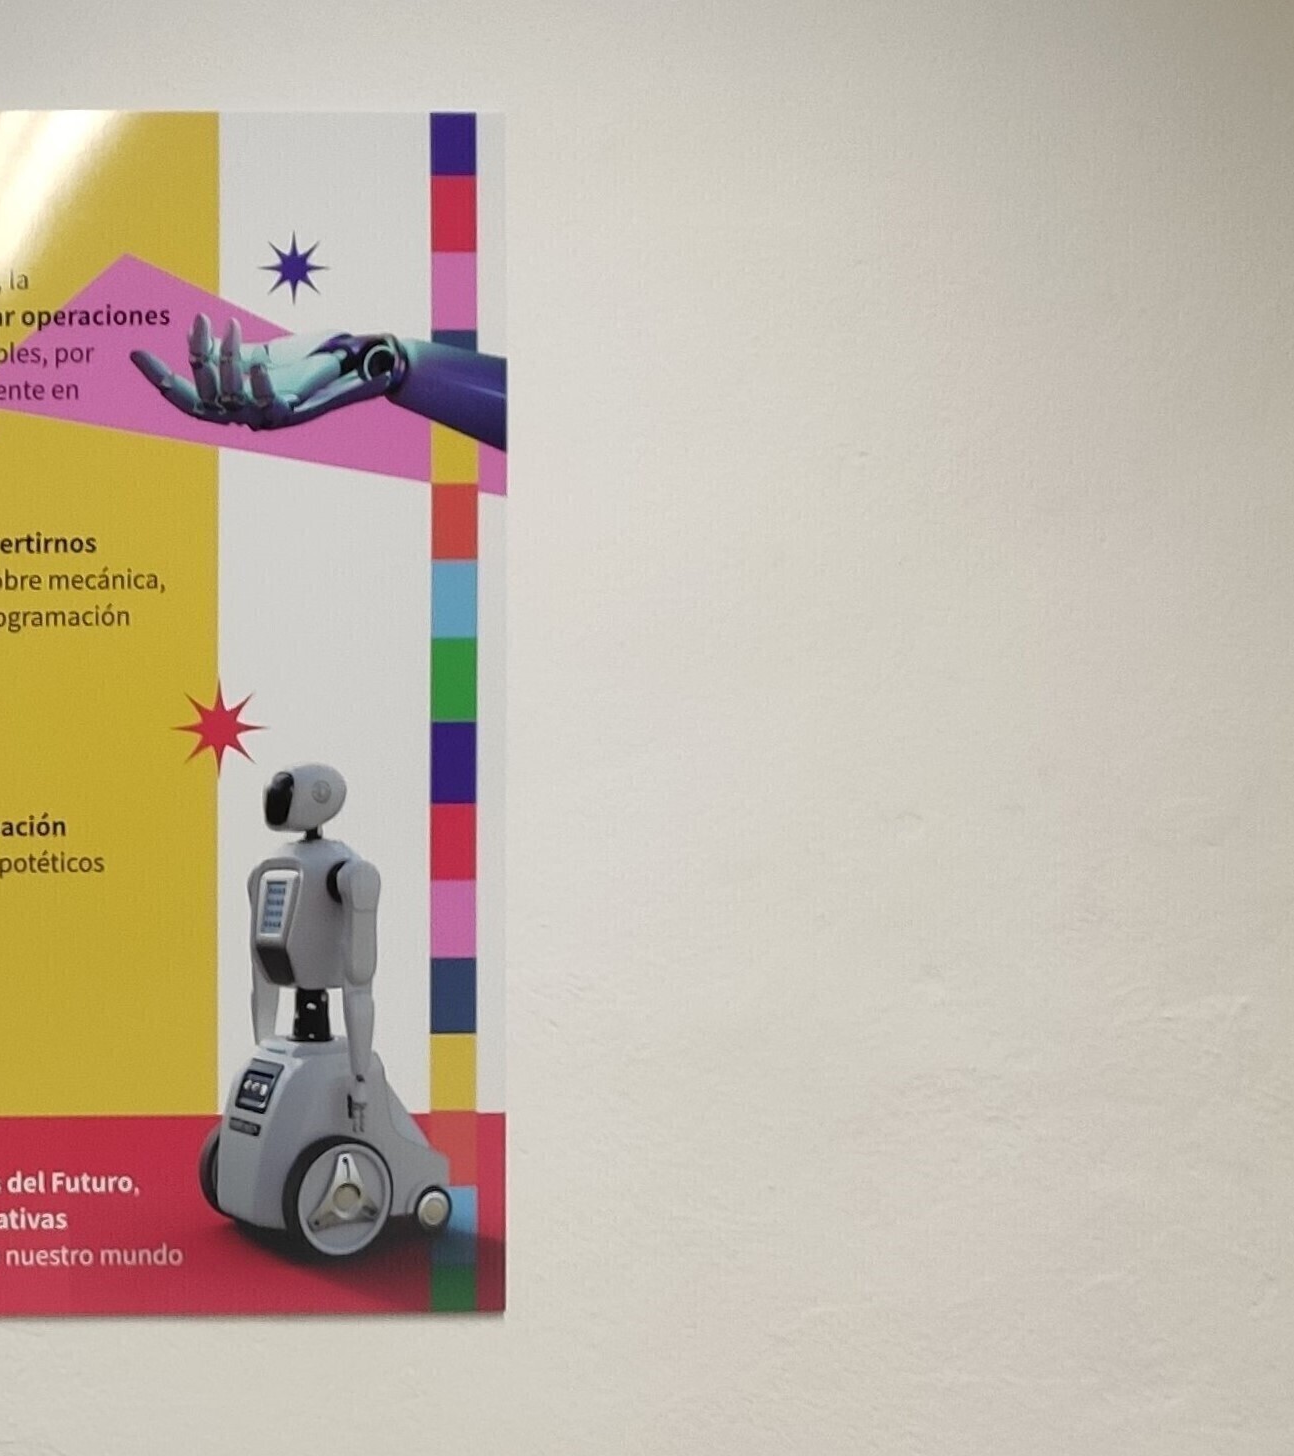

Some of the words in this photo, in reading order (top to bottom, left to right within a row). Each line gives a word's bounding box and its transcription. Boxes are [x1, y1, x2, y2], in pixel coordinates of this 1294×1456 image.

[21, 304, 170, 331] operaciones
[55, 347, 94, 369] por
[49, 567, 165, 593] mecánica,
[7, 1170, 45, 1193] del
[52, 1172, 139, 1195] Futuro,
[6, 1246, 93, 1266] nuestro
[100, 1243, 183, 1265] mundo
